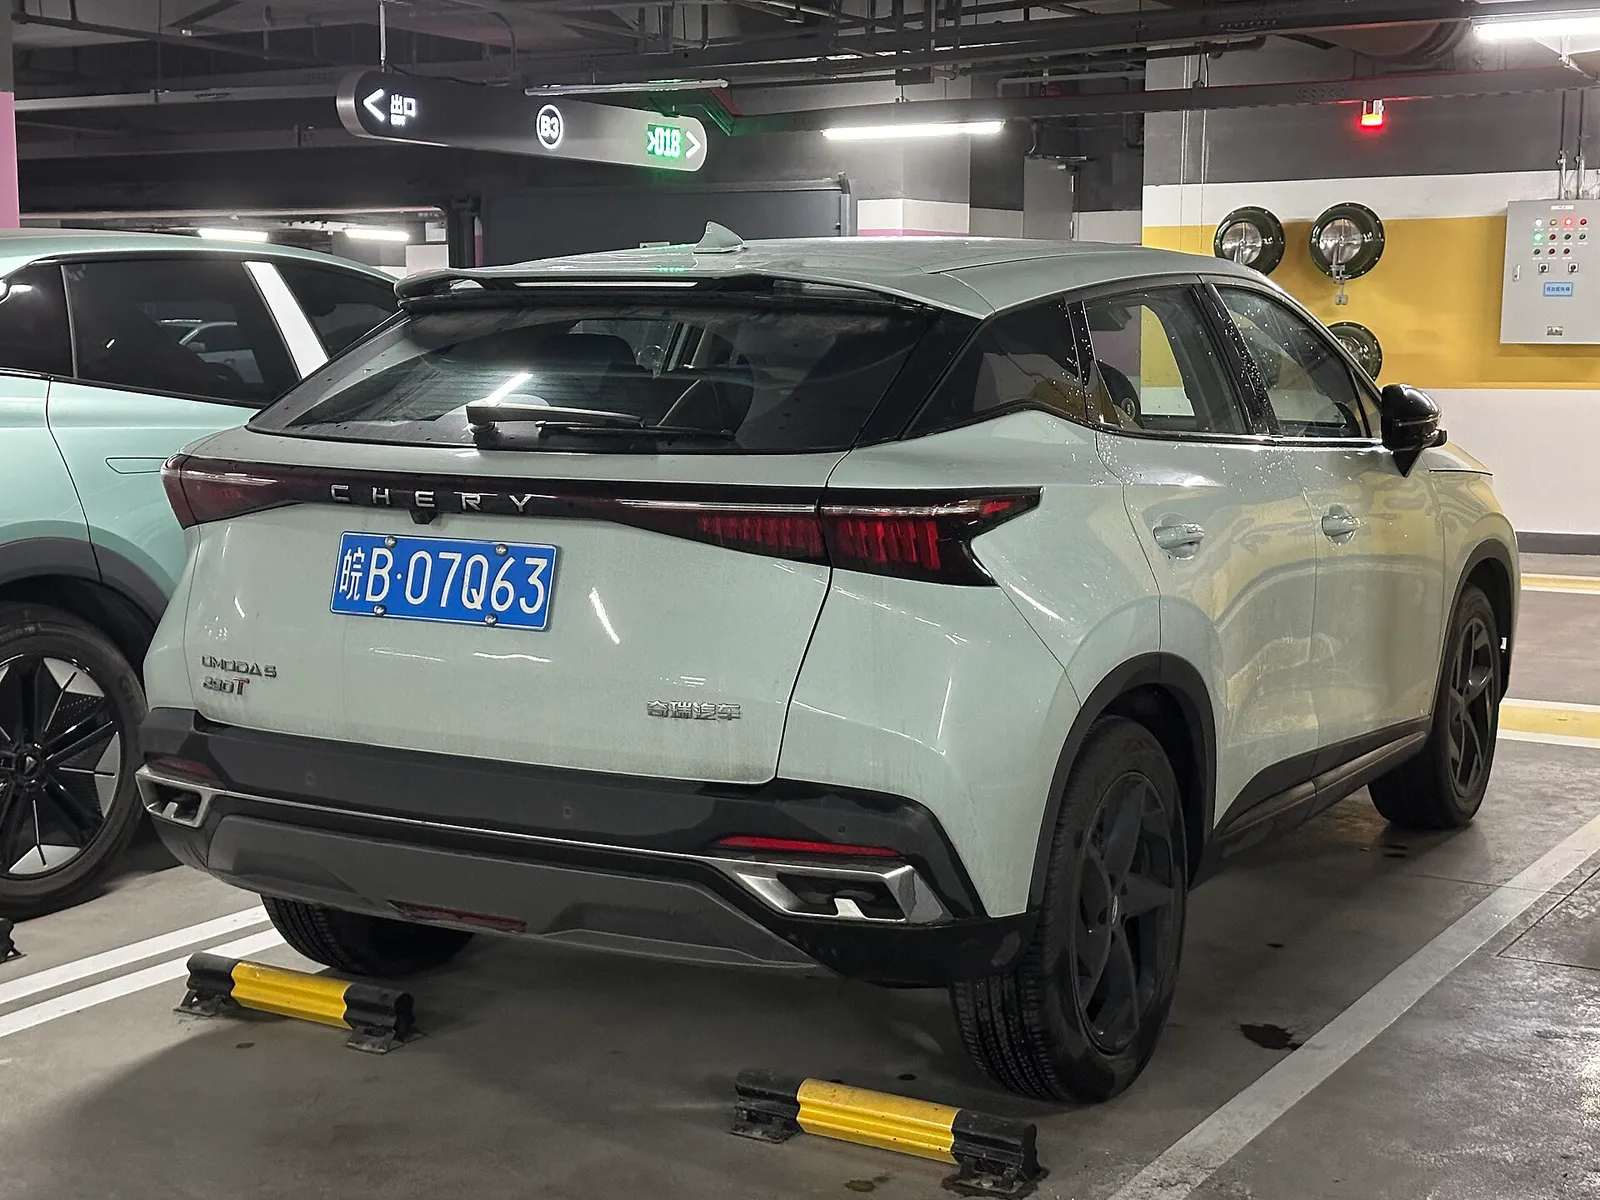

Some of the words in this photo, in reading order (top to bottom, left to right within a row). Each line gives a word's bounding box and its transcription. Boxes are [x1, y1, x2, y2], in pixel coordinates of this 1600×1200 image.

[390, 93, 416, 117] 出口
[540, 116, 560, 139] B3
[330, 484, 536, 513] CHERY
[647, 699, 741, 721] 奇瑞汽车
